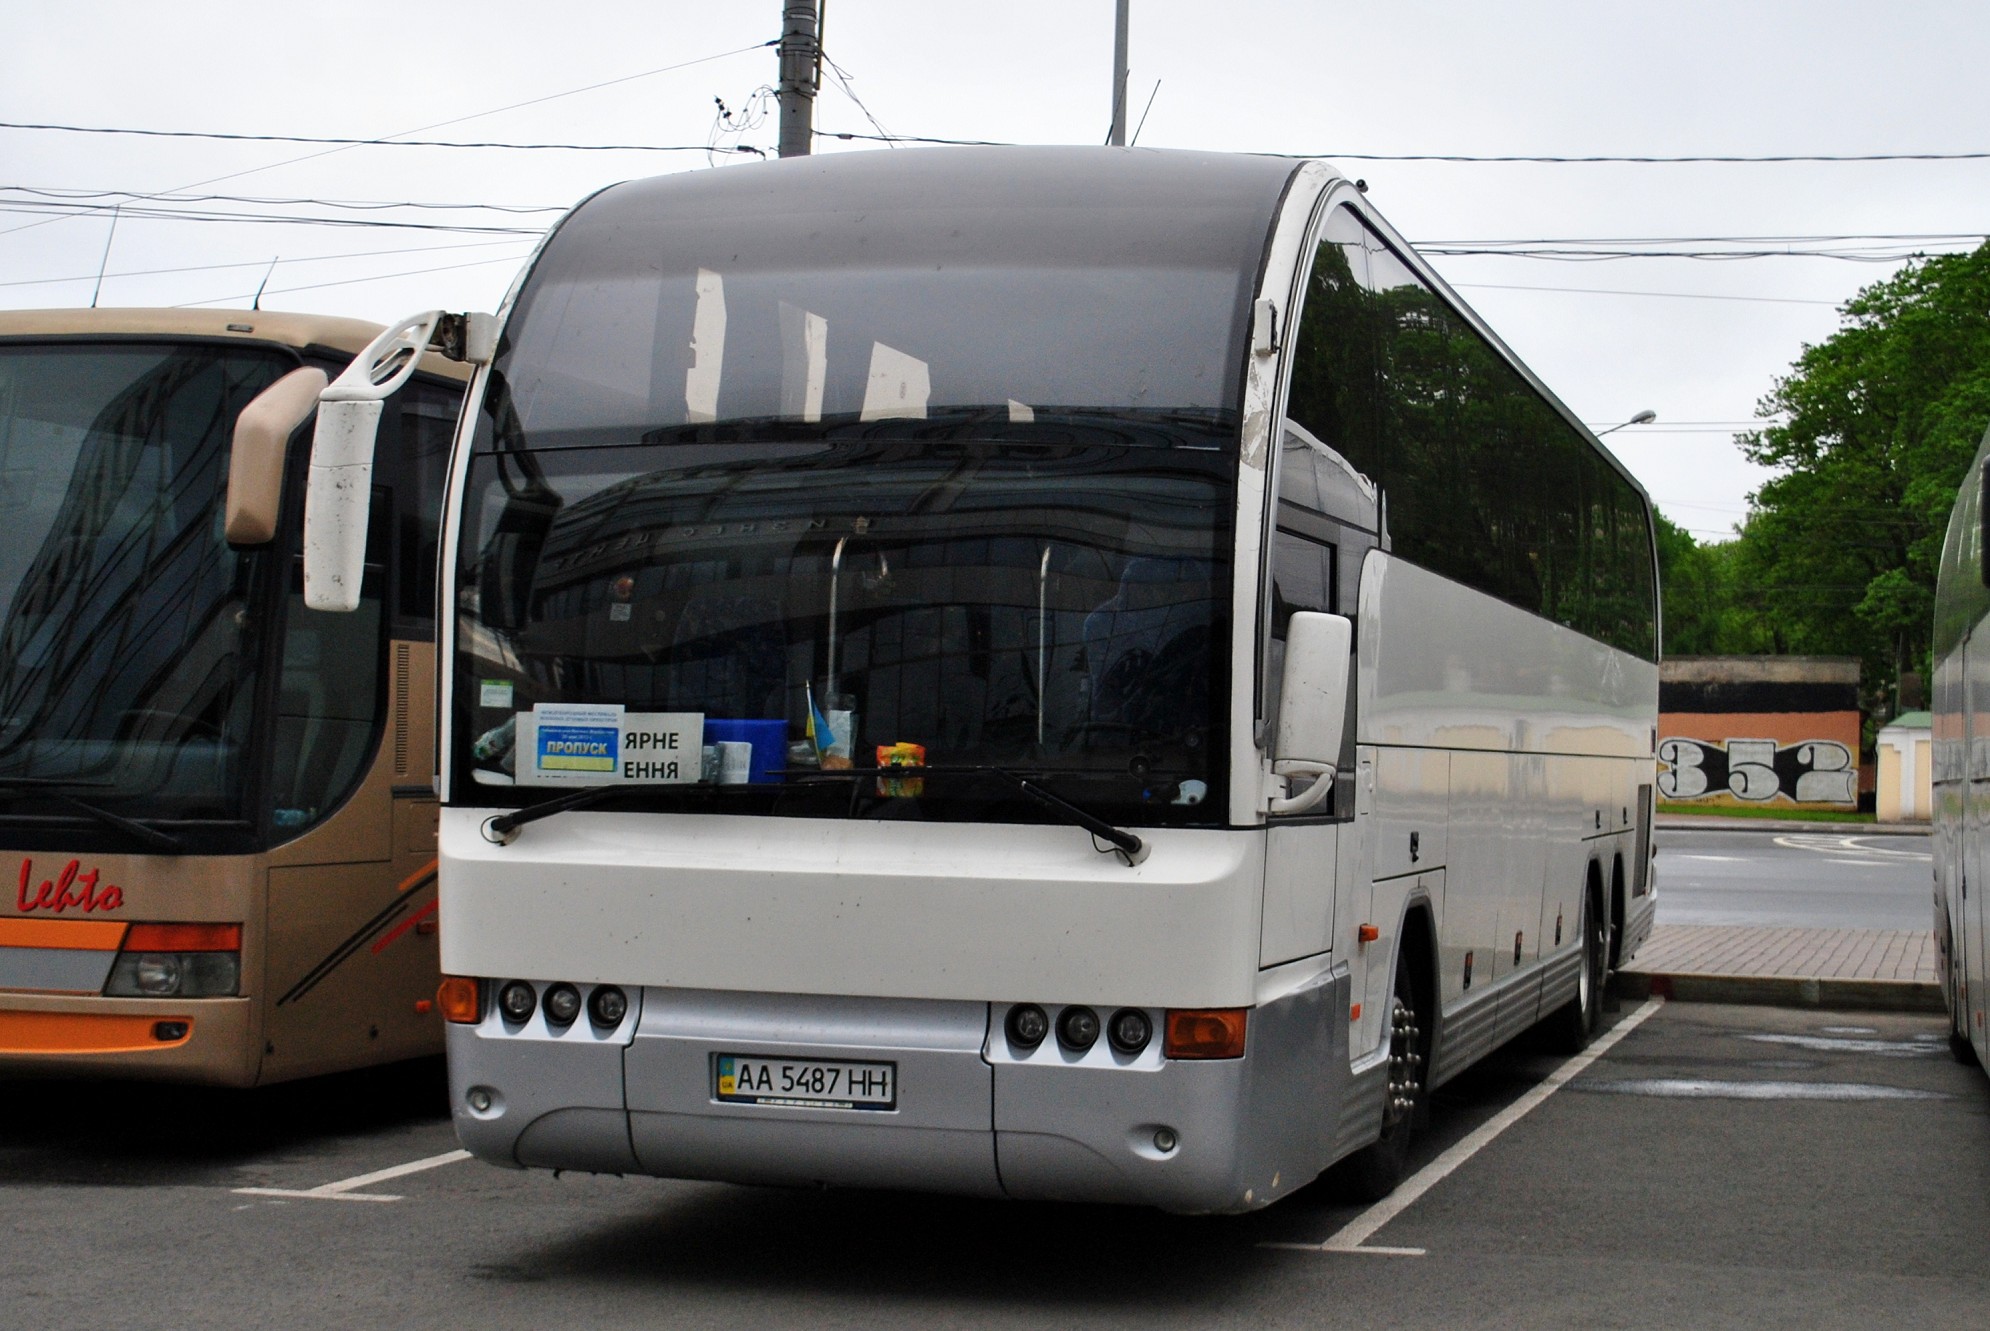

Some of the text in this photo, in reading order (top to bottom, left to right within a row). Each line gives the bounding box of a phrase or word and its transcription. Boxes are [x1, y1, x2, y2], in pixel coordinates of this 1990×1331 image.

[546, 740, 608, 755] ПРОПУСК
[1657, 737, 1859, 807] 352
[17, 857, 124, 913] Lehto
[737, 1063, 887, 1097] AA 5487 HH
